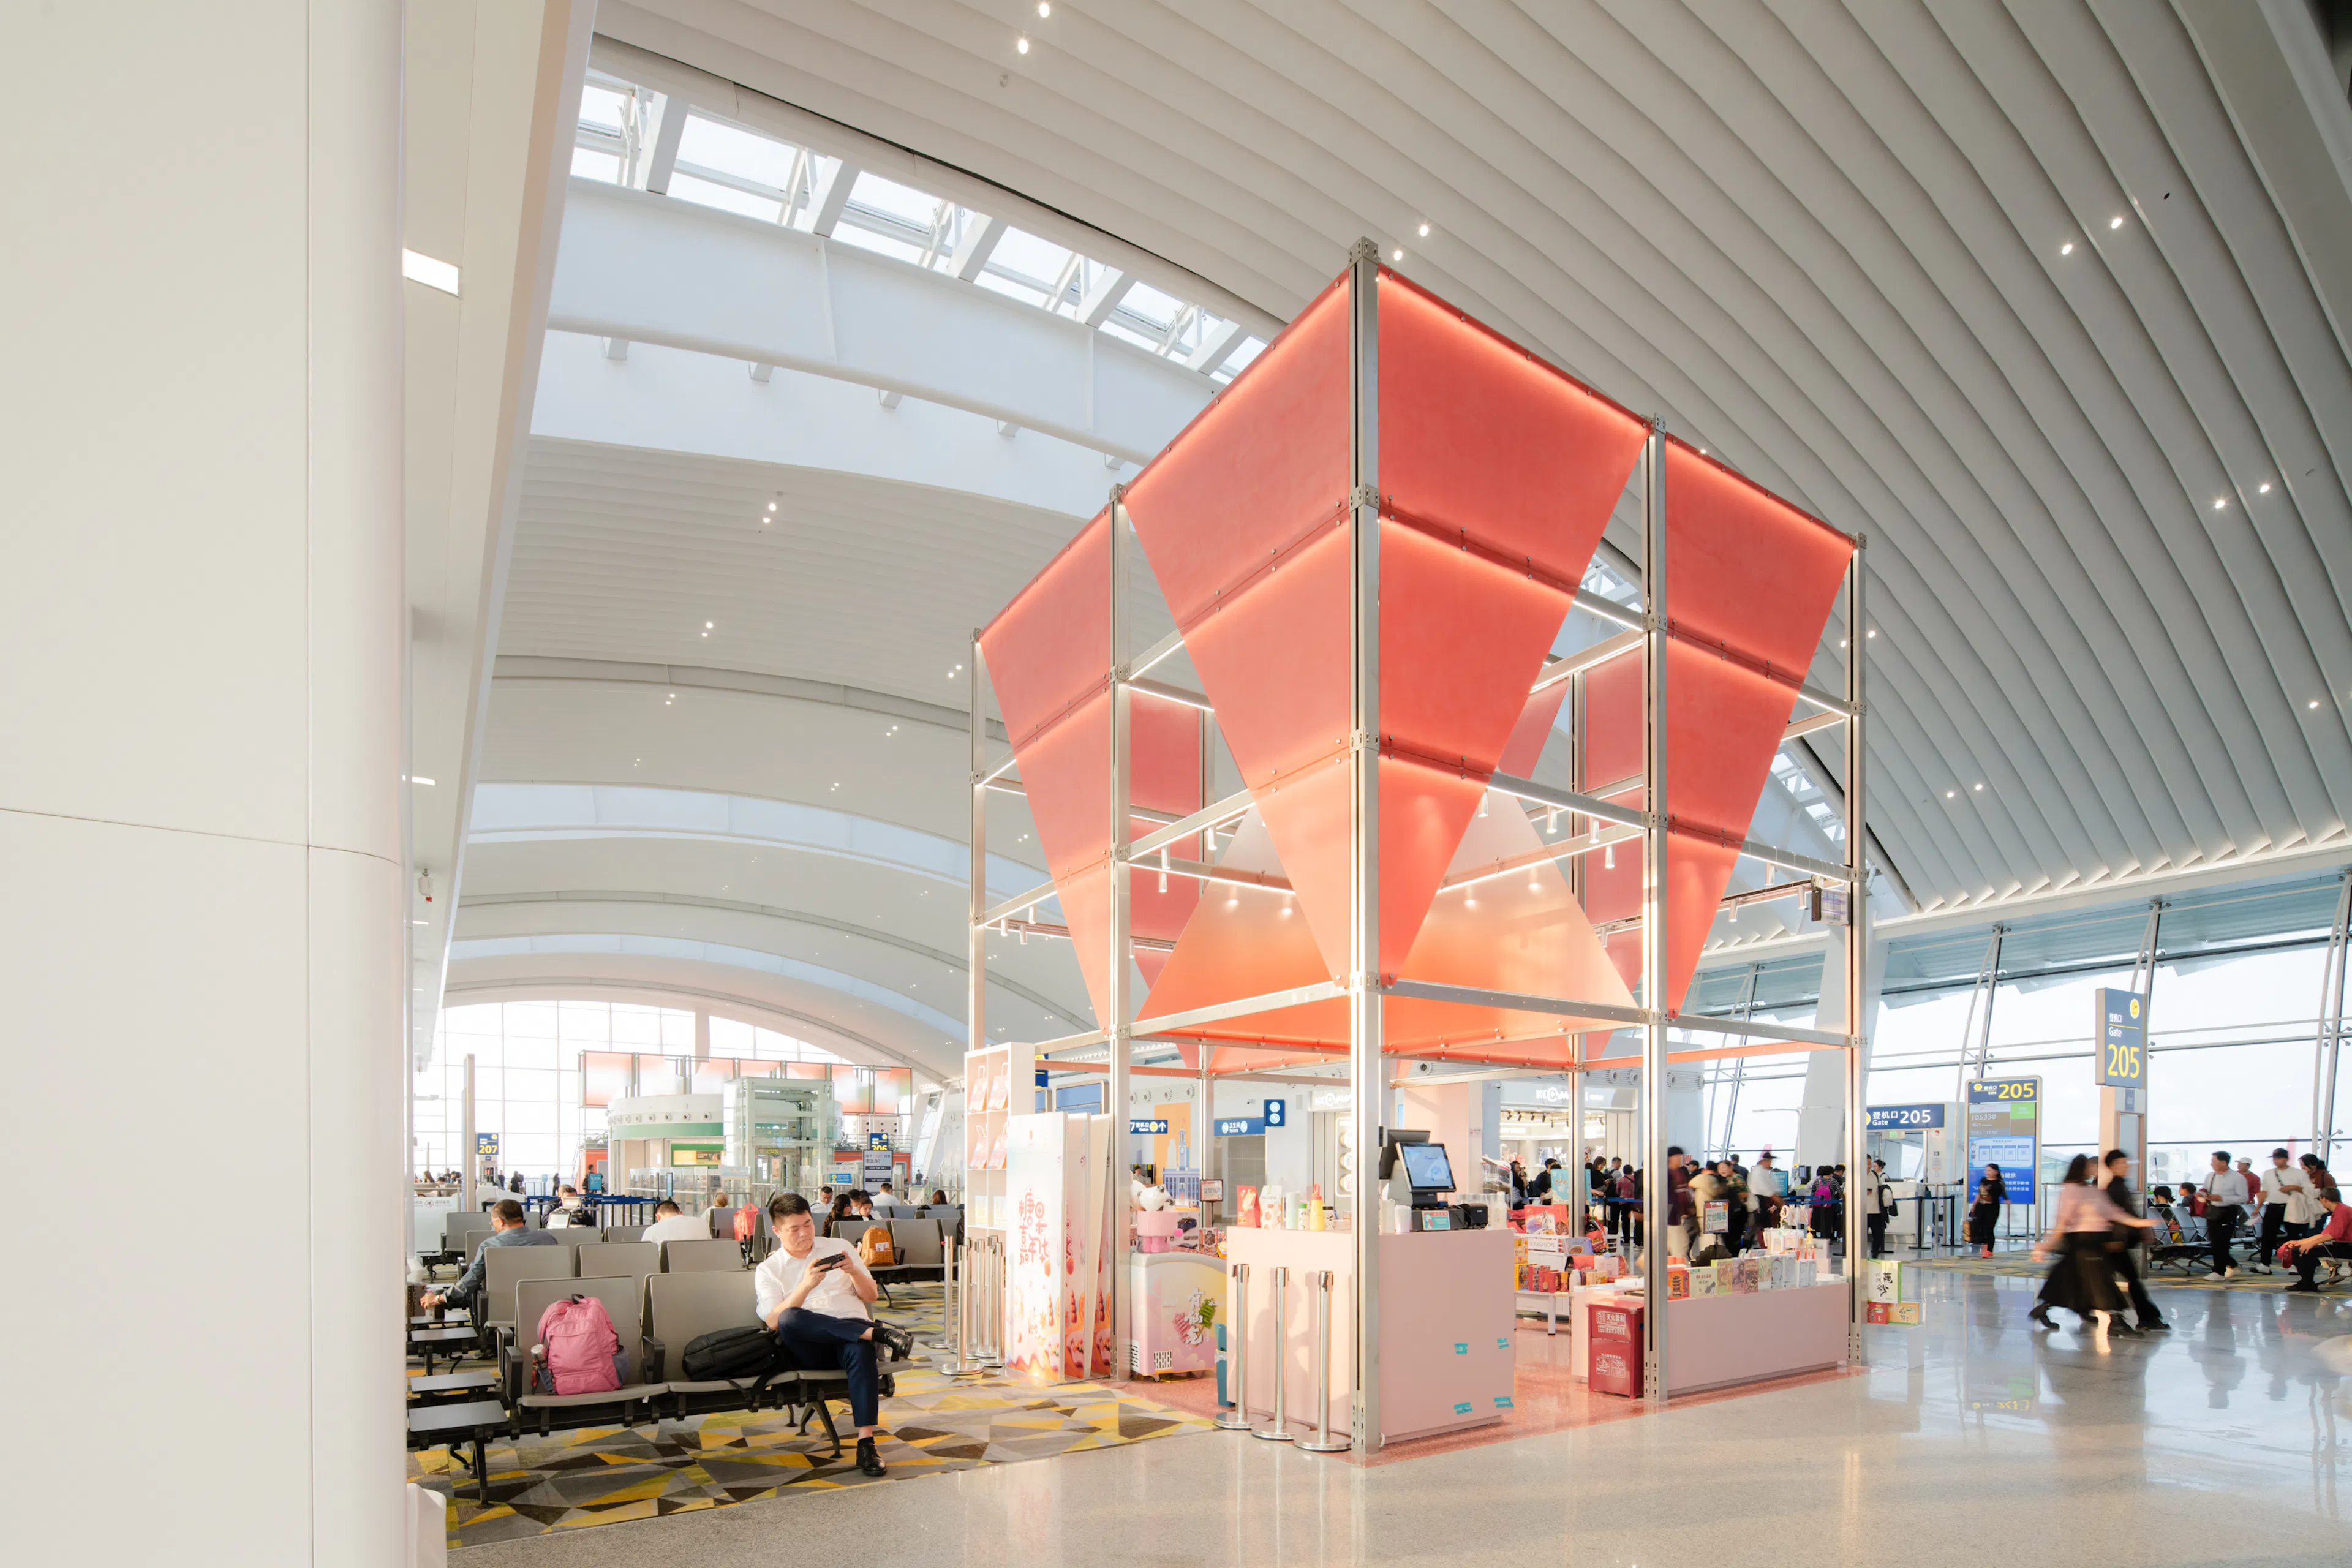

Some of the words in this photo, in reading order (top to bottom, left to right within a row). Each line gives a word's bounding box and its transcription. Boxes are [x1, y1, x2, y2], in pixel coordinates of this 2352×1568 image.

[2109, 1013, 2122, 1023] 登机口
[2109, 1027, 2122, 1037] Gate
[2108, 1044, 2139, 1078] 205
[1998, 1082, 2034, 1099] 205
[1872, 1110, 1898, 1120] 登机口
[1899, 1109, 1931, 1124] 205
[478, 1145, 498, 1154] 207
